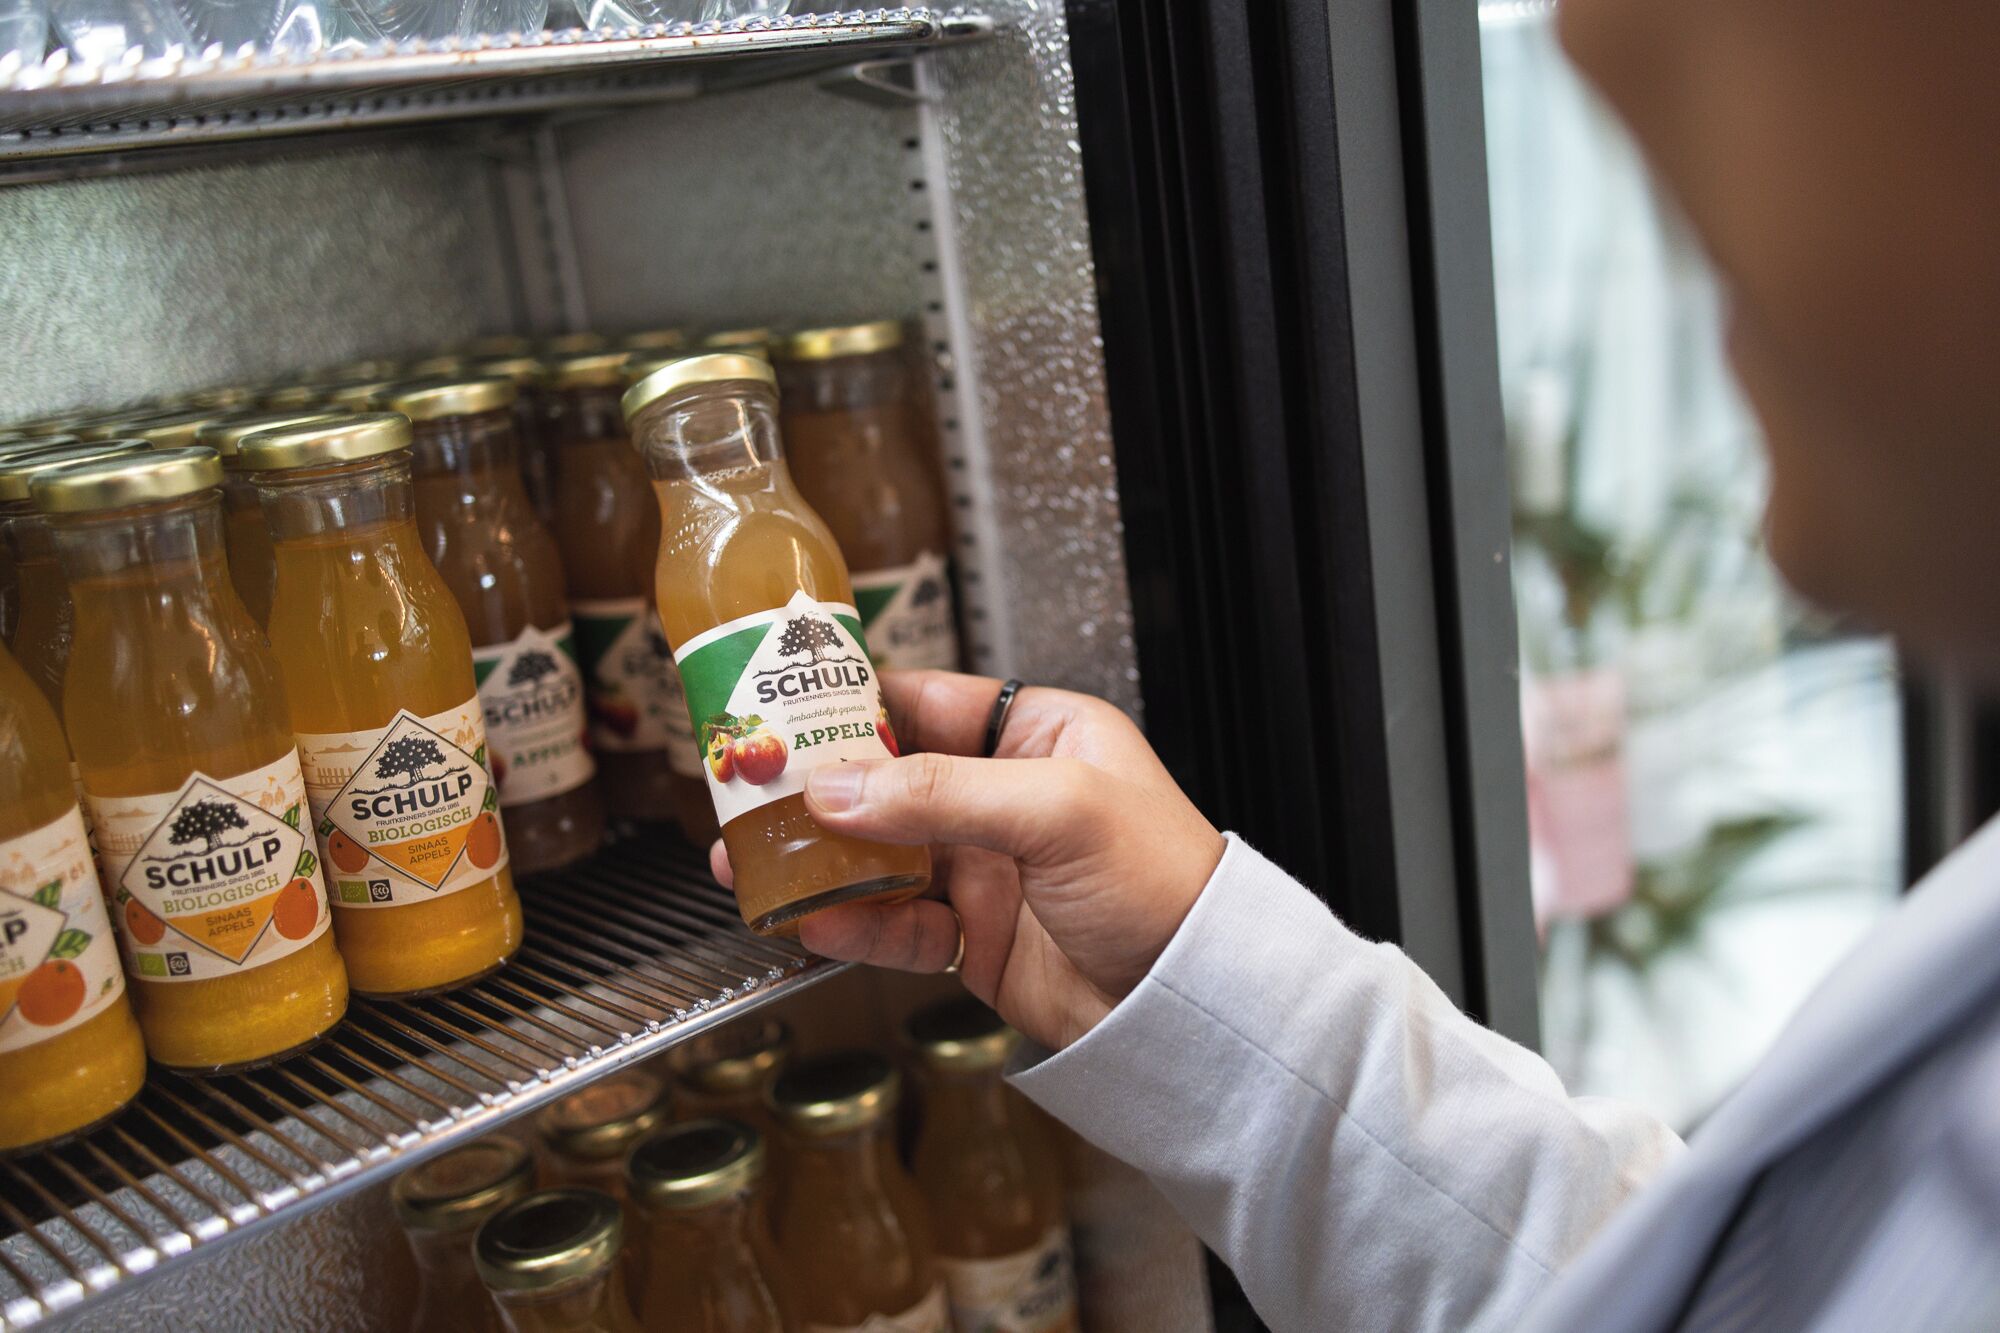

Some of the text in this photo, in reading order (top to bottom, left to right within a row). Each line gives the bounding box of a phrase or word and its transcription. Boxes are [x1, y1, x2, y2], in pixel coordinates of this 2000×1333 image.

[756, 666, 869, 704] SCHULP
[782, 691, 832, 707] FRUITKENNERS
[794, 722, 875, 750] APPELS
[351, 773, 472, 820] SCHULP
[367, 806, 473, 843] BIOLOGISCH
[376, 811, 427, 827] FRUITKENNERS
[427, 806, 447, 816] SINDS
[408, 836, 449, 854] SINAAS
[409, 847, 451, 865] APPELS
[145, 837, 281, 890] SCHULP
[163, 873, 281, 914] BIOLOGISCH
[206, 906, 252, 926] SINAAS
[208, 919, 255, 937] APPELS
